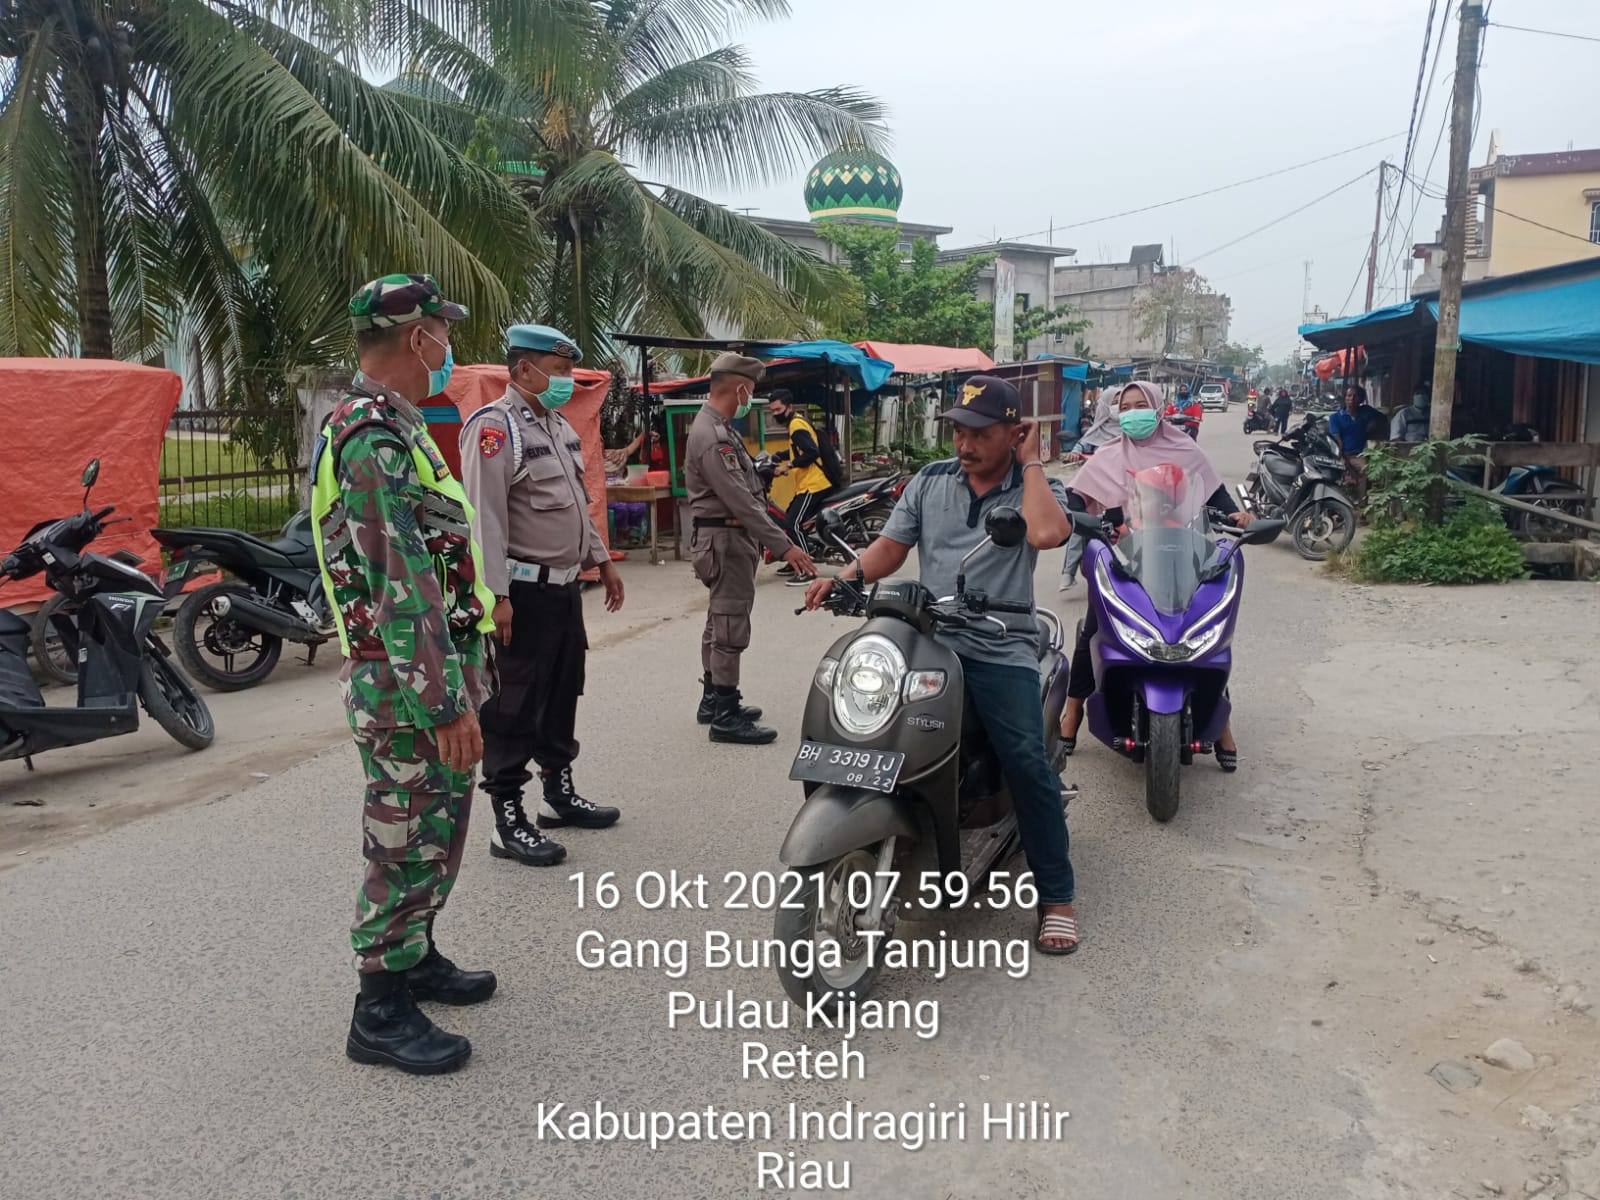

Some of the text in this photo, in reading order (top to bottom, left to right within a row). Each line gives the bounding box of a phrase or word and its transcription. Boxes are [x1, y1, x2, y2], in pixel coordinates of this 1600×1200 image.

[108, 596, 135, 604] HONDA
[798, 744, 896, 772] BH 3319 IJ
[846, 772, 893, 788] 08 22
